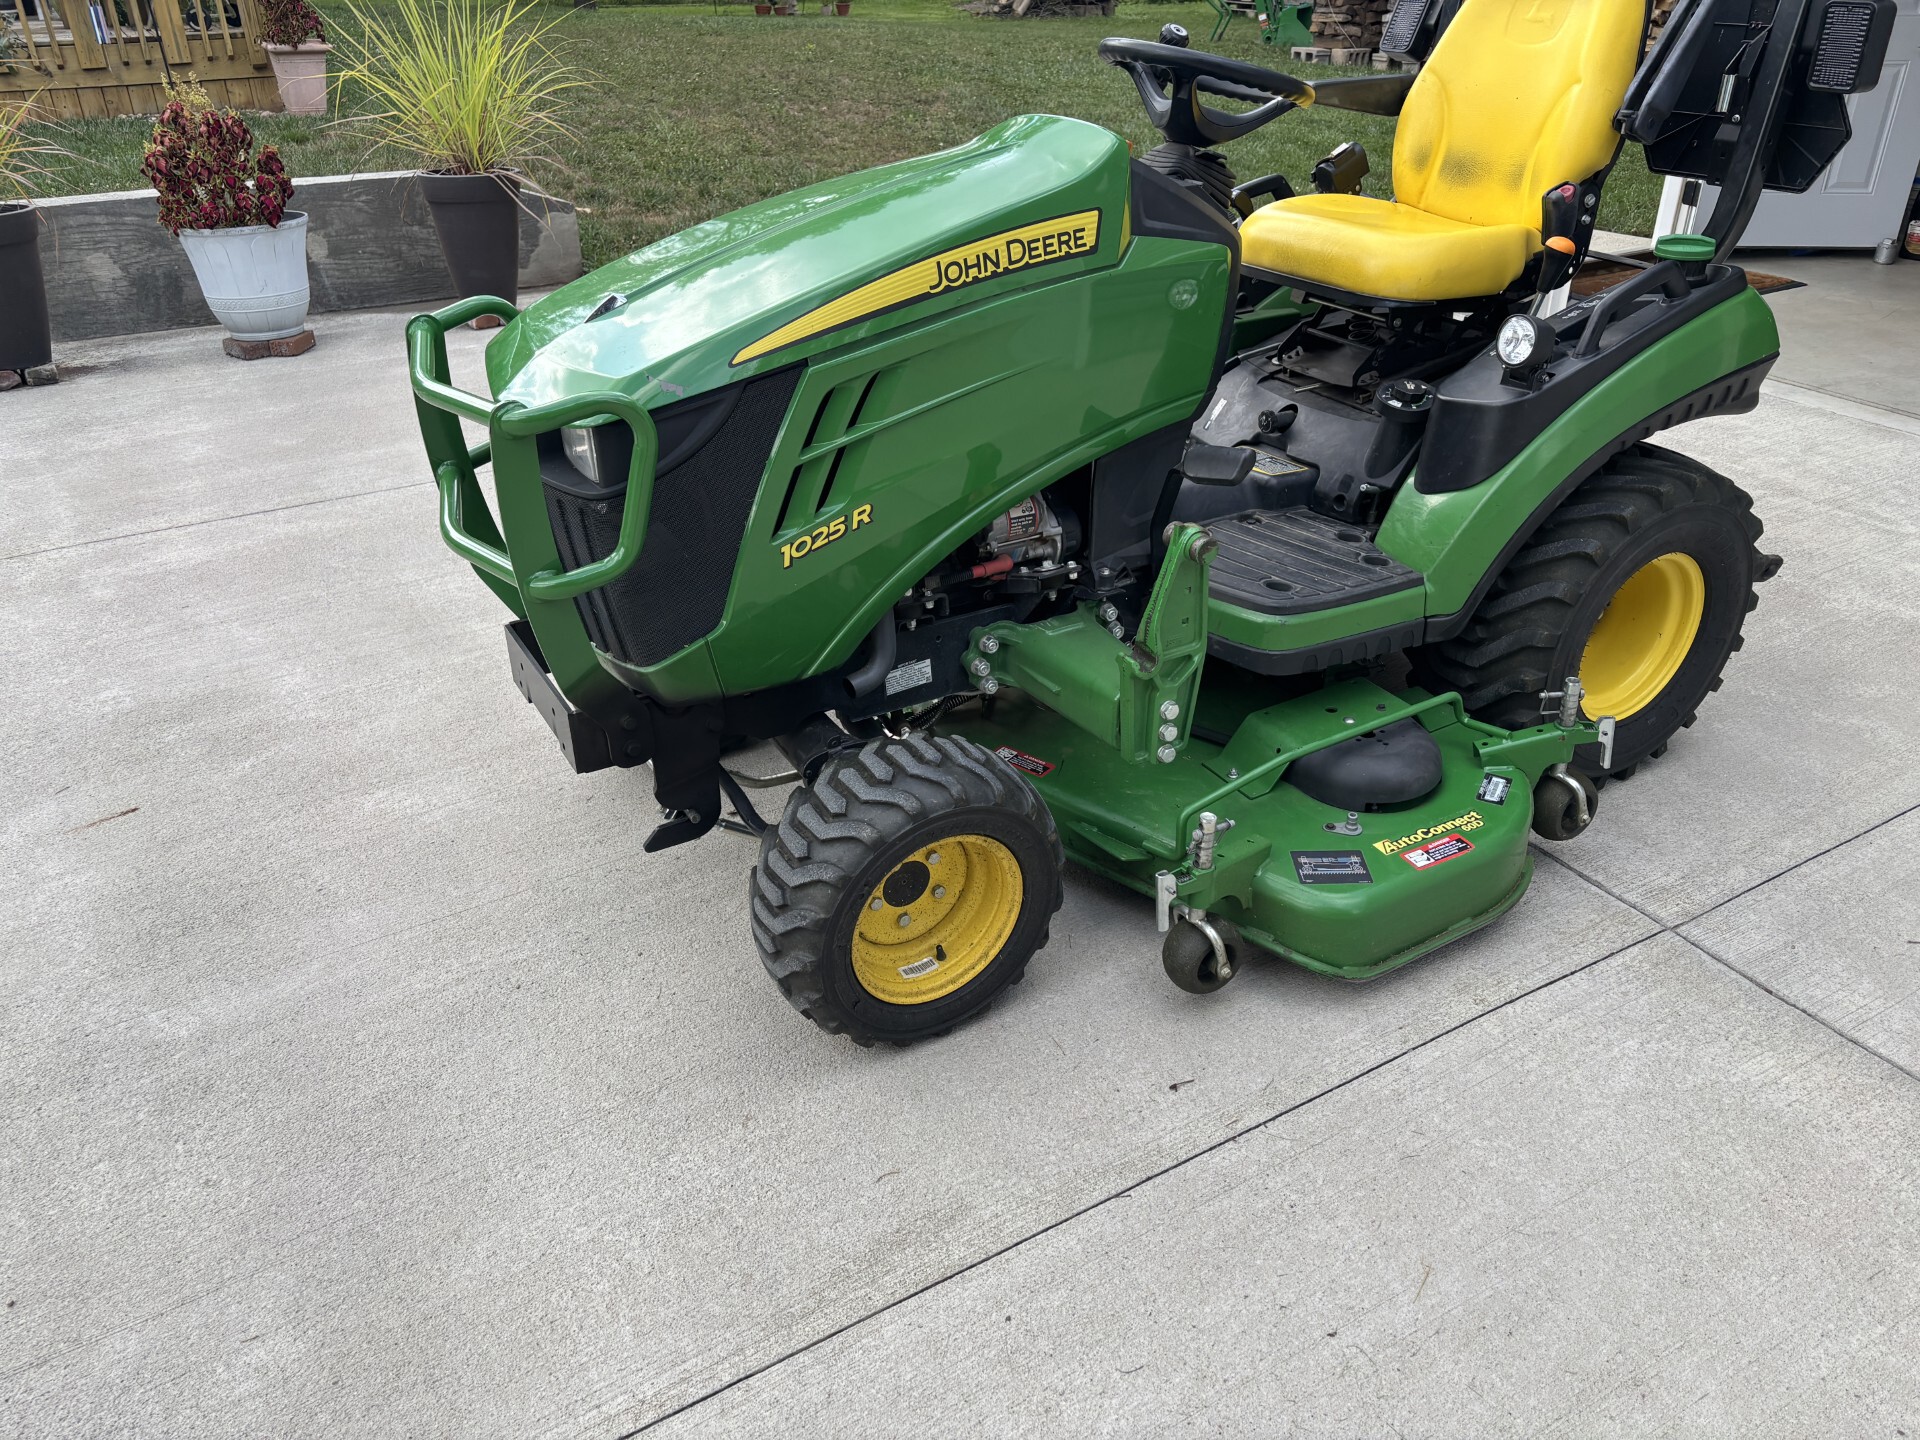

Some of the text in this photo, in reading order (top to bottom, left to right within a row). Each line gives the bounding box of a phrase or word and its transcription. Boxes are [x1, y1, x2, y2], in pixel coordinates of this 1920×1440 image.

[929, 227, 1088, 291] JOHN DEERE
[780, 503, 873, 569] 1025 R
[1381, 810, 1483, 855] AutoConnect
[1460, 819, 1485, 832] 60D
